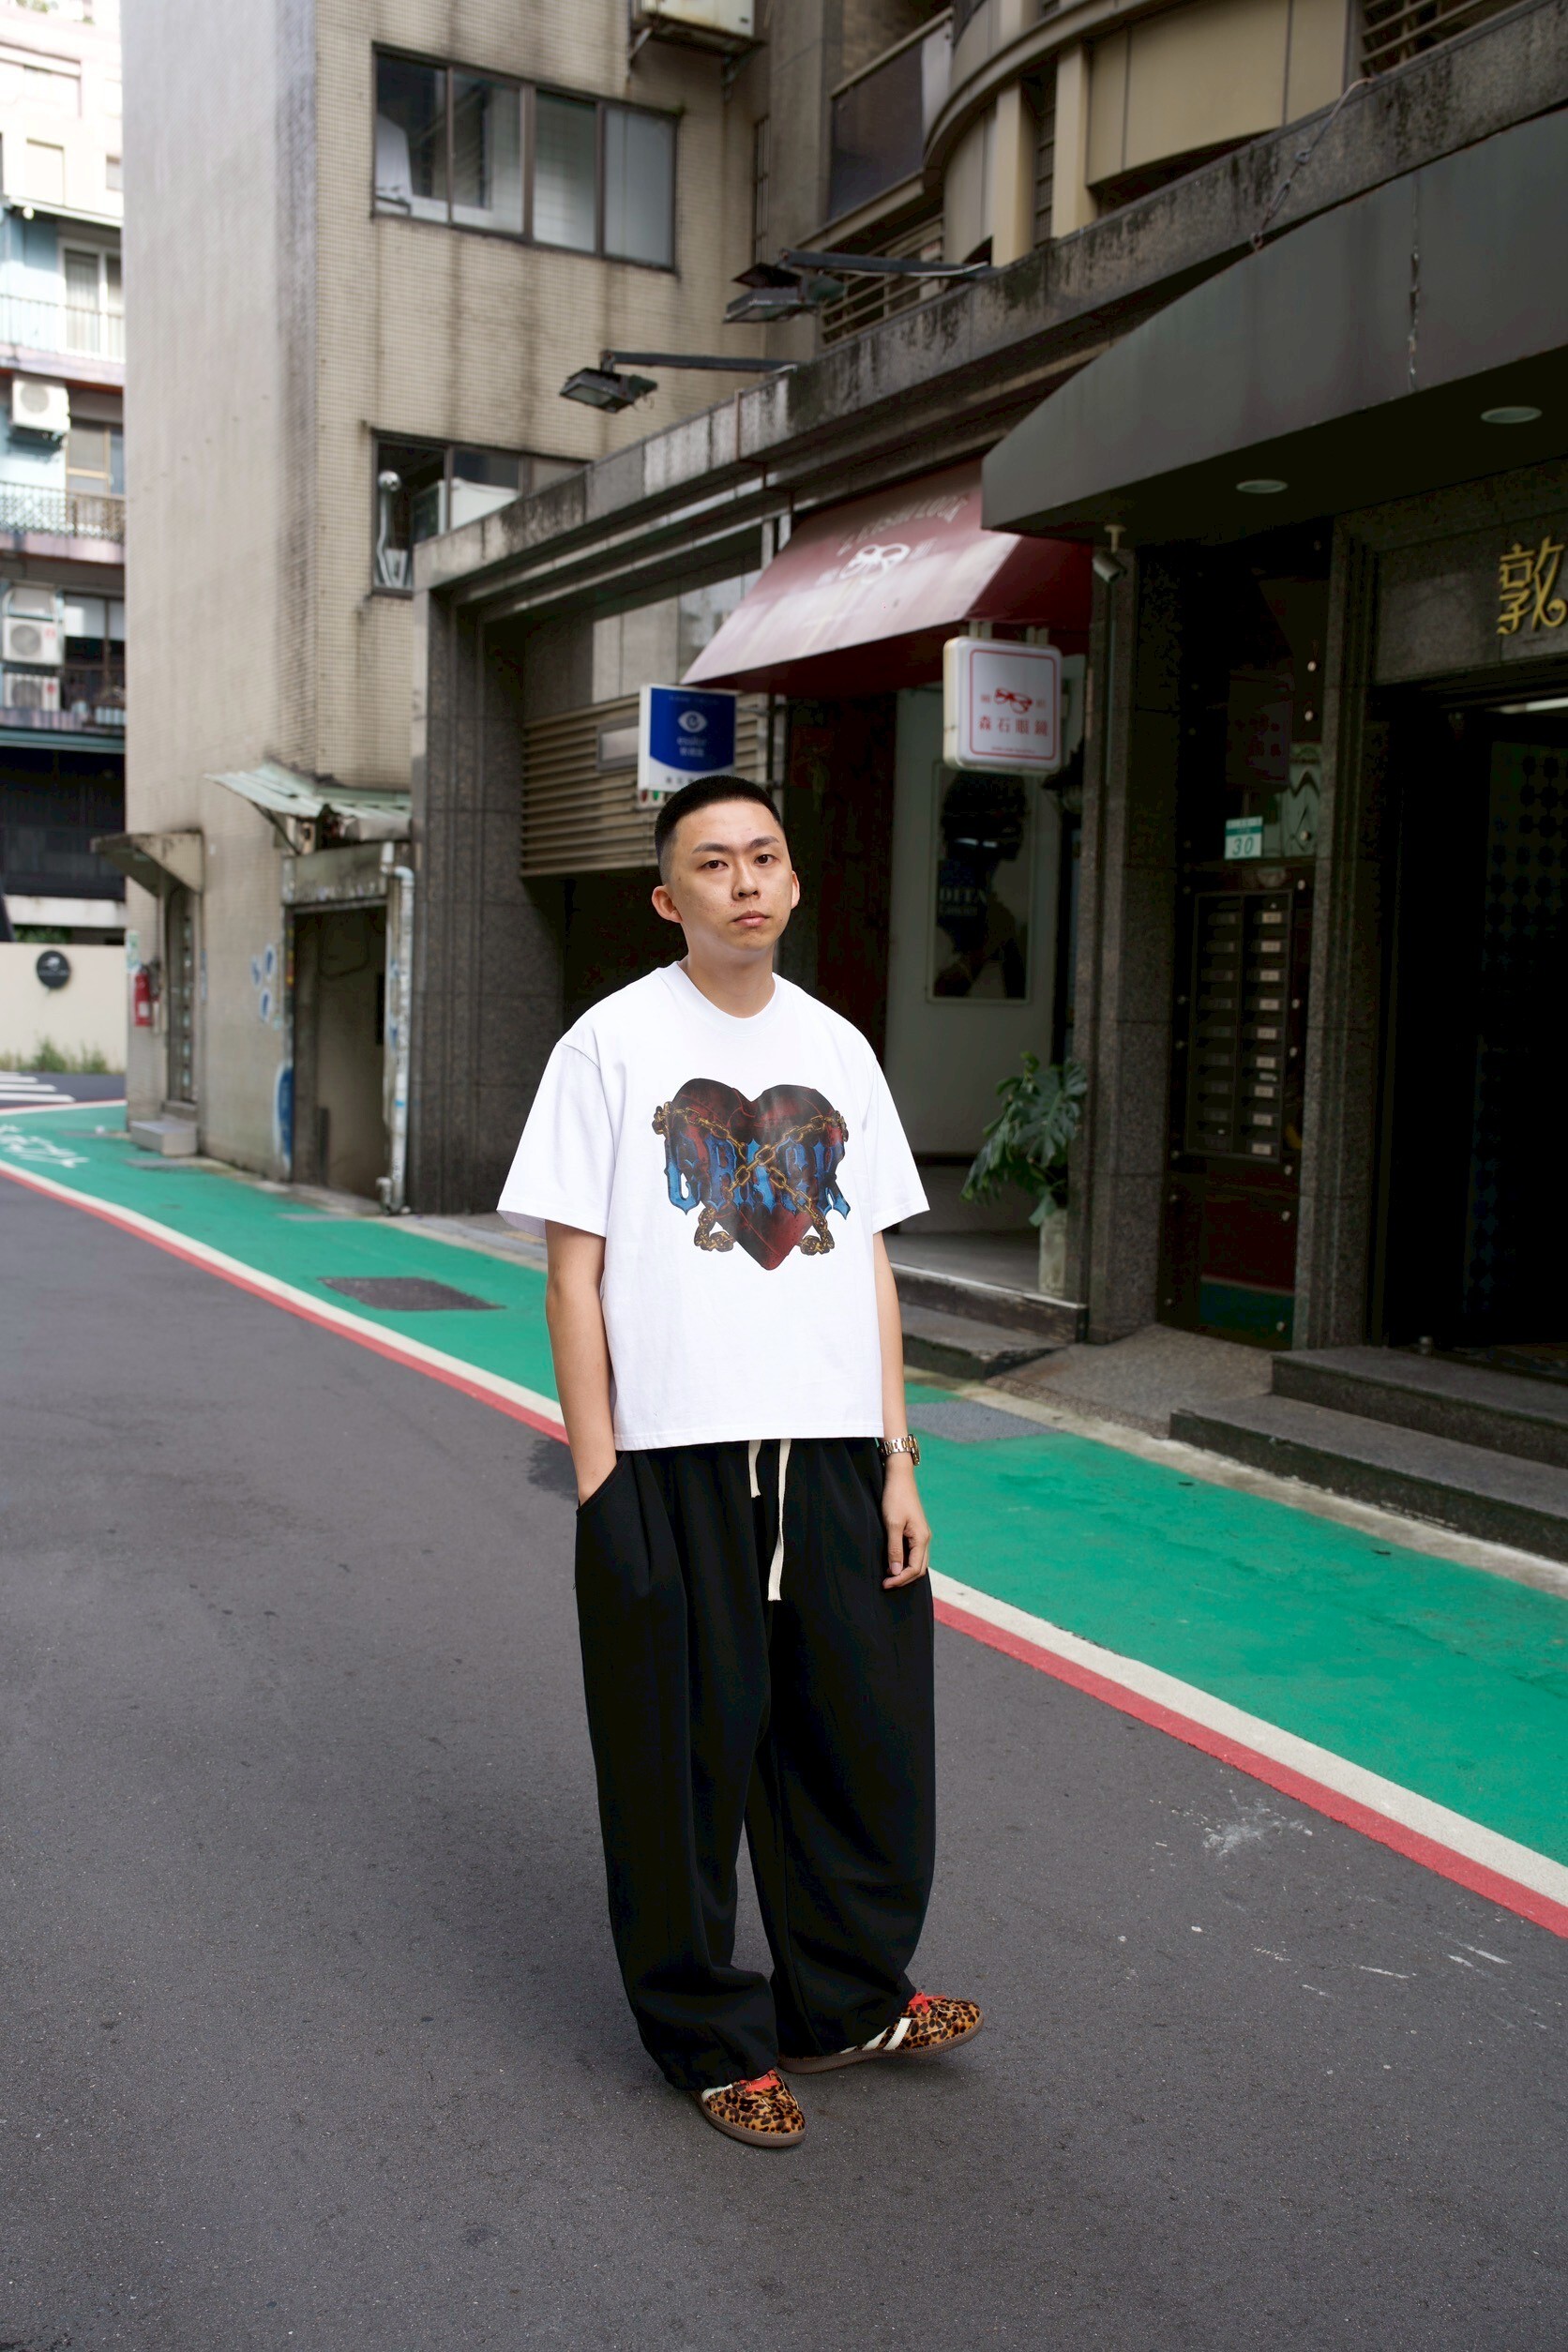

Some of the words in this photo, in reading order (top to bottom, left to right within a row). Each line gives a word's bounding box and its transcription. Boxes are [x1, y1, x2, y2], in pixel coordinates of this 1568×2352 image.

[1497, 535, 1567, 635] 敦
[979, 715, 1048, 736] 森石眼鏡
[1232, 837, 1254, 856] 30
